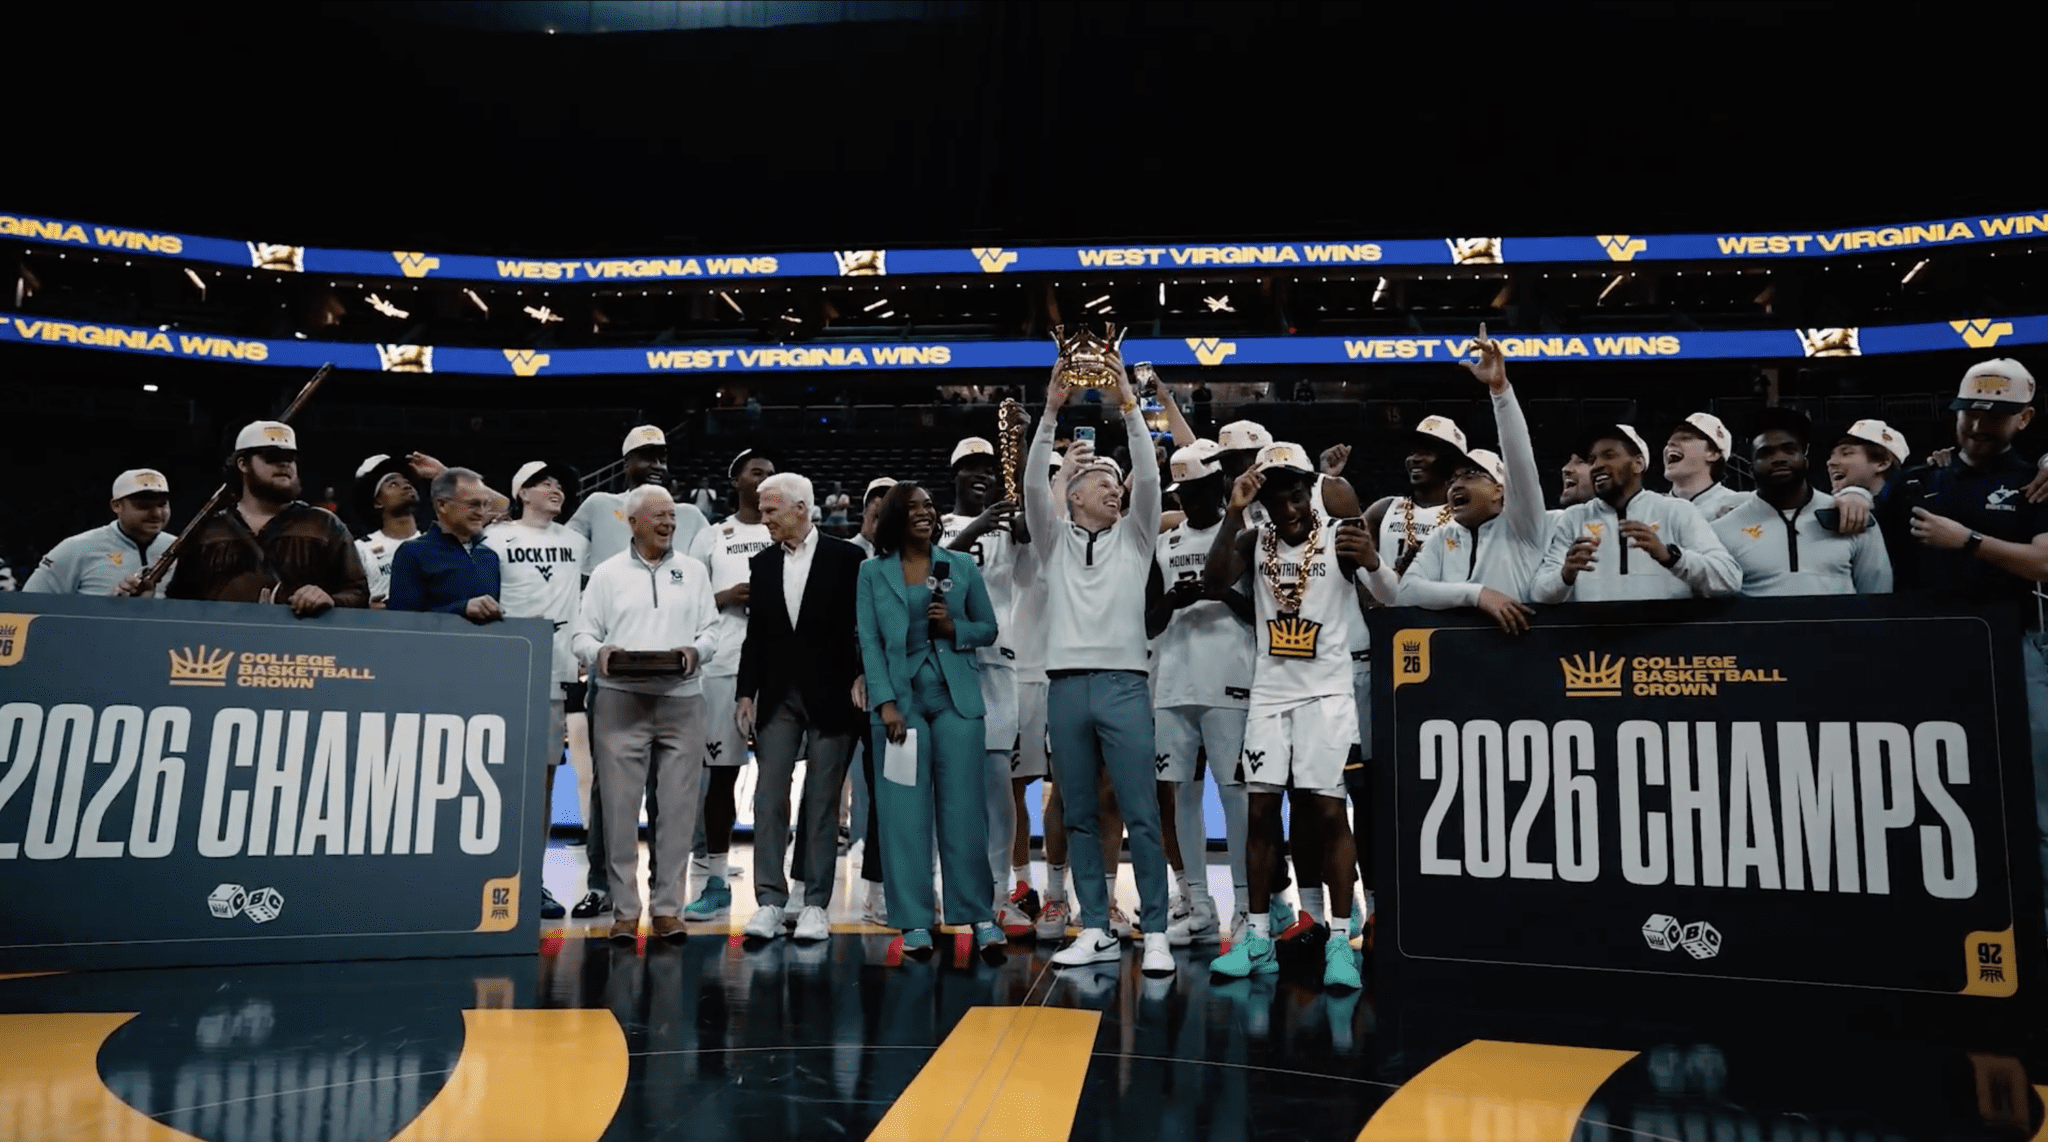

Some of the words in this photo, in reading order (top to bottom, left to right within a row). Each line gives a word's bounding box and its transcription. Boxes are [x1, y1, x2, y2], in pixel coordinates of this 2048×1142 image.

[94, 228, 182, 254] WINS
[1717, 235, 1812, 255] WEST
[1816, 221, 1974, 252] VIRGINIA
[1078, 248, 1165, 266] WEST
[1169, 246, 1299, 264] VIRGINIA
[1304, 243, 1381, 261] WINS
[497, 261, 580, 279] WEST
[584, 260, 701, 278] VIRGINIA
[706, 257, 777, 275] WINS
[14, 318, 173, 352] VIRGINIA
[179, 335, 268, 361] WINS
[1344, 339, 1440, 358] WEST
[1593, 335, 1680, 355] WINS
[646, 350, 734, 369] WEST
[737, 348, 867, 367] VIRGINIA
[872, 346, 950, 364] WINS
[507, 548, 542, 564] LOCK
[545, 547, 557, 563] IT
[560, 547, 576, 563] IN.
[239, 652, 337, 668] COLLEGE
[1402, 655, 1421, 674] 26
[1631, 655, 1738, 670] COLLEGE
[236, 676, 315, 690] CROWN
[237, 664, 376, 680] BASKETBALL
[1631, 668, 1788, 683] BASKETBALL
[1632, 682, 1718, 697] CROWN
[0, 702, 192, 860] 2026
[197, 707, 507, 859] CHAMPS
[1419, 719, 1601, 882] 2026
[1616, 720, 1978, 899] CHAMPS
[492, 887, 511, 906] 26
[1977, 942, 2003, 965] 26
